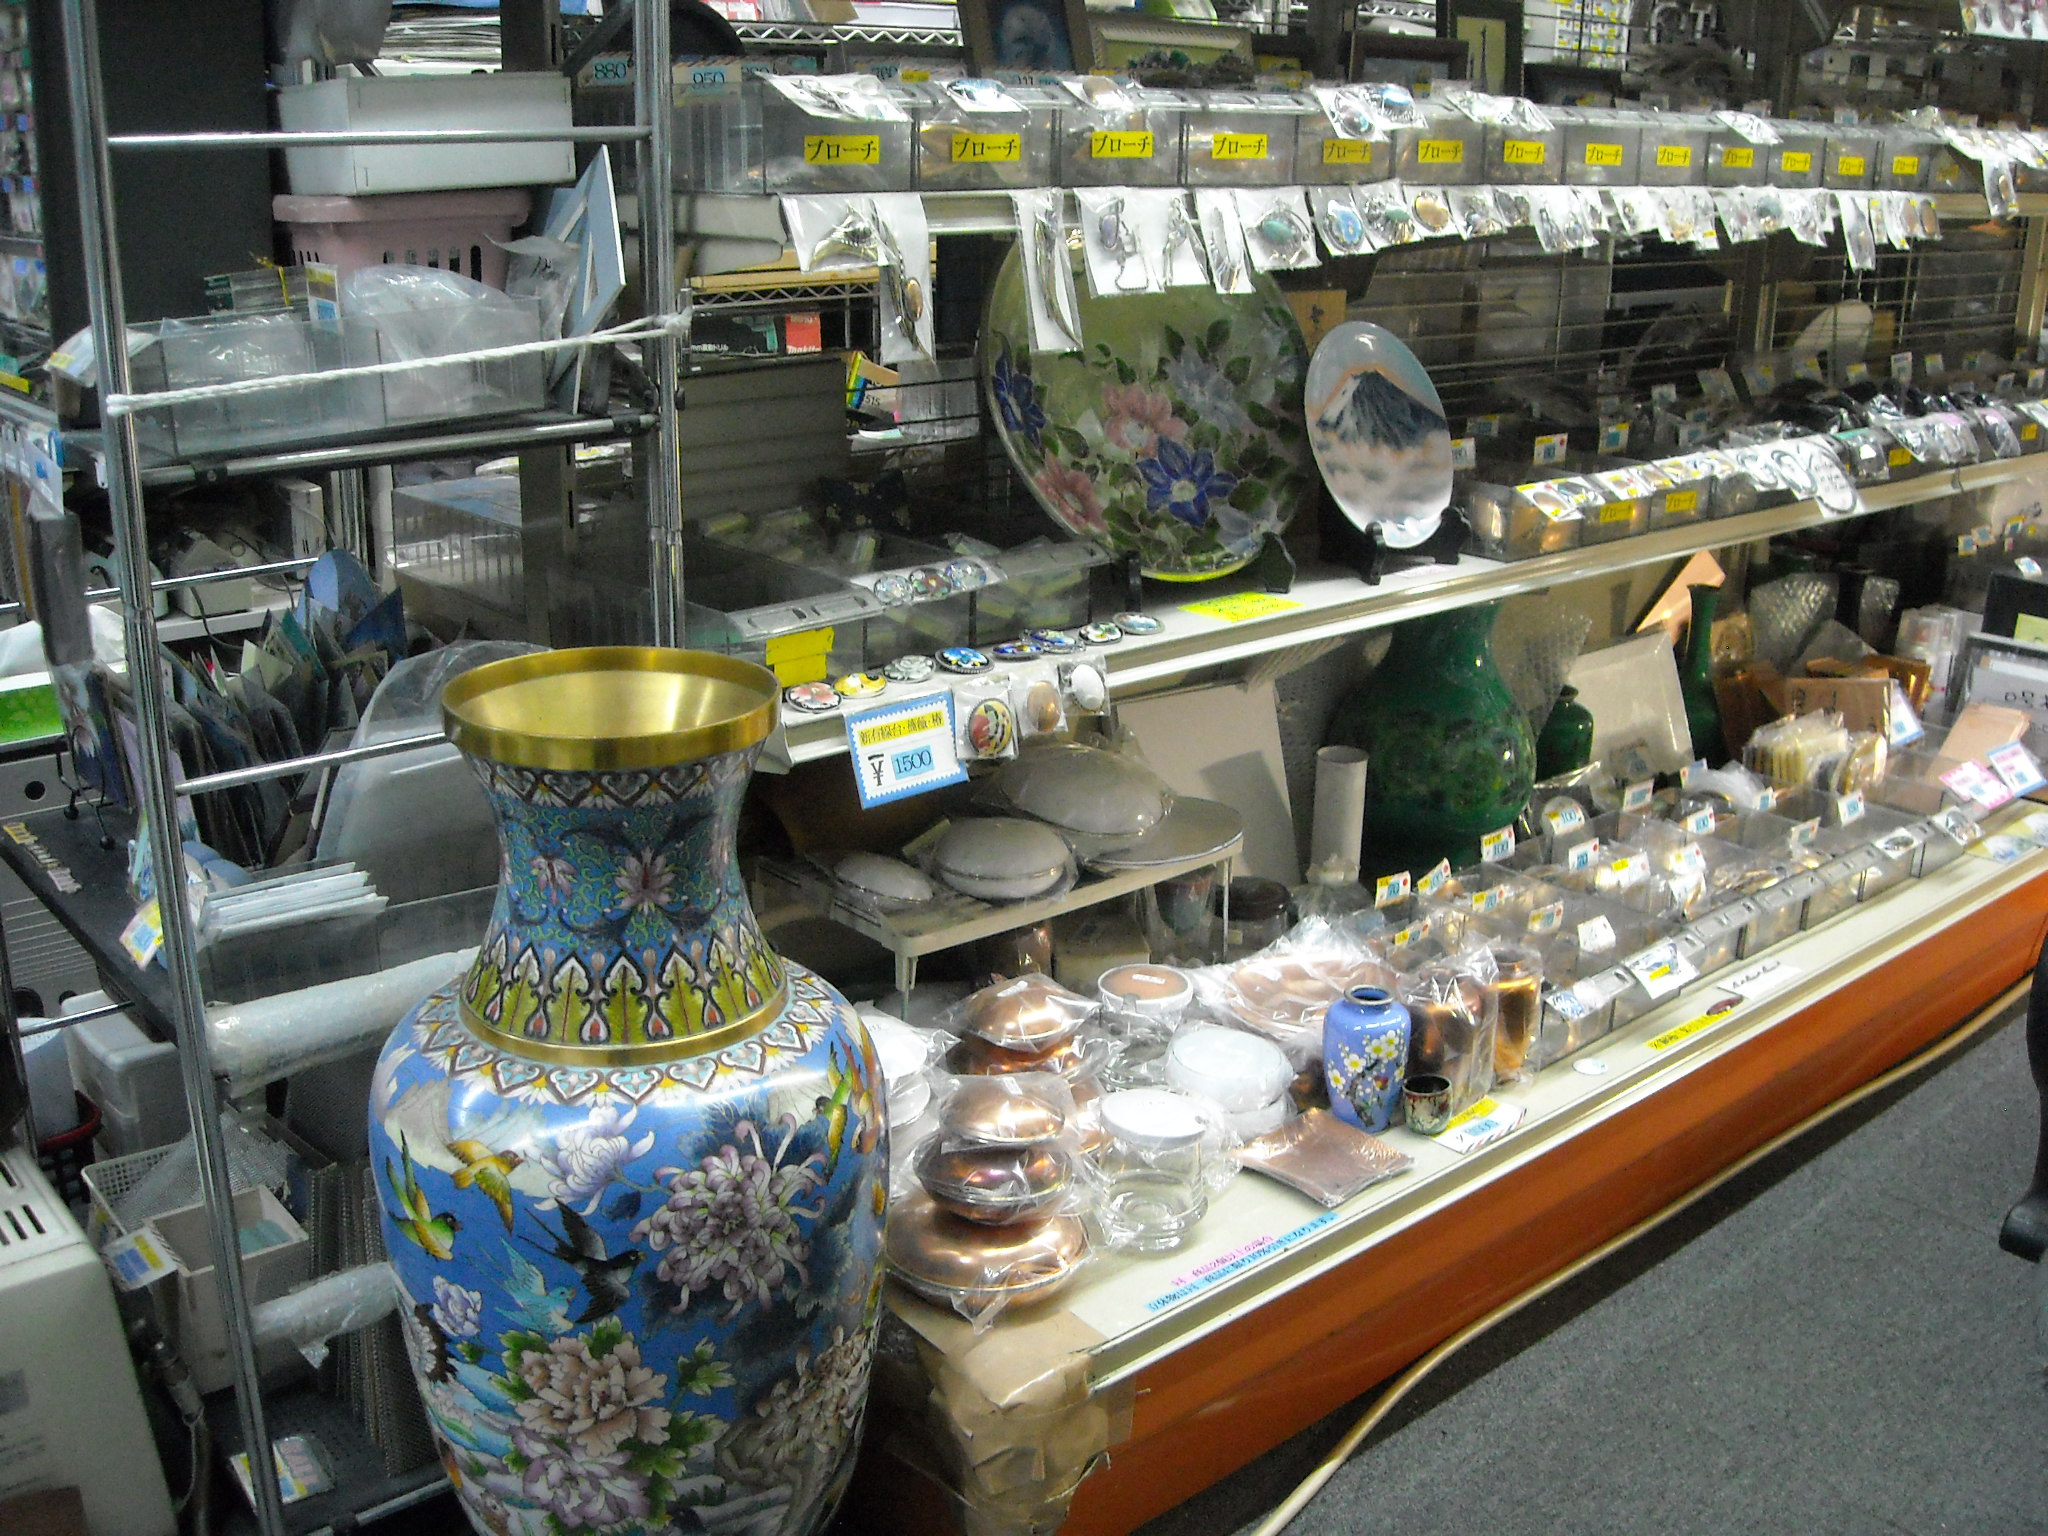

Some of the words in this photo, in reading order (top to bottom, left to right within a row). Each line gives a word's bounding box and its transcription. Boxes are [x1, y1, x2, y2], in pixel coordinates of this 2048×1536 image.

[806, 138, 879, 163] ブローチ
[954, 136, 1019, 160] ブローチ
[1093, 134, 1151, 157] ブローチ
[1215, 135, 1266, 158] ブローチ
[1325, 143, 1370, 159] ブローチ
[1421, 143, 1462, 160] ブローチ
[1506, 143, 1543, 160] ブローチ
[1588, 146, 1621, 163] ブローチ
[895, 750, 932, 775] 1500
